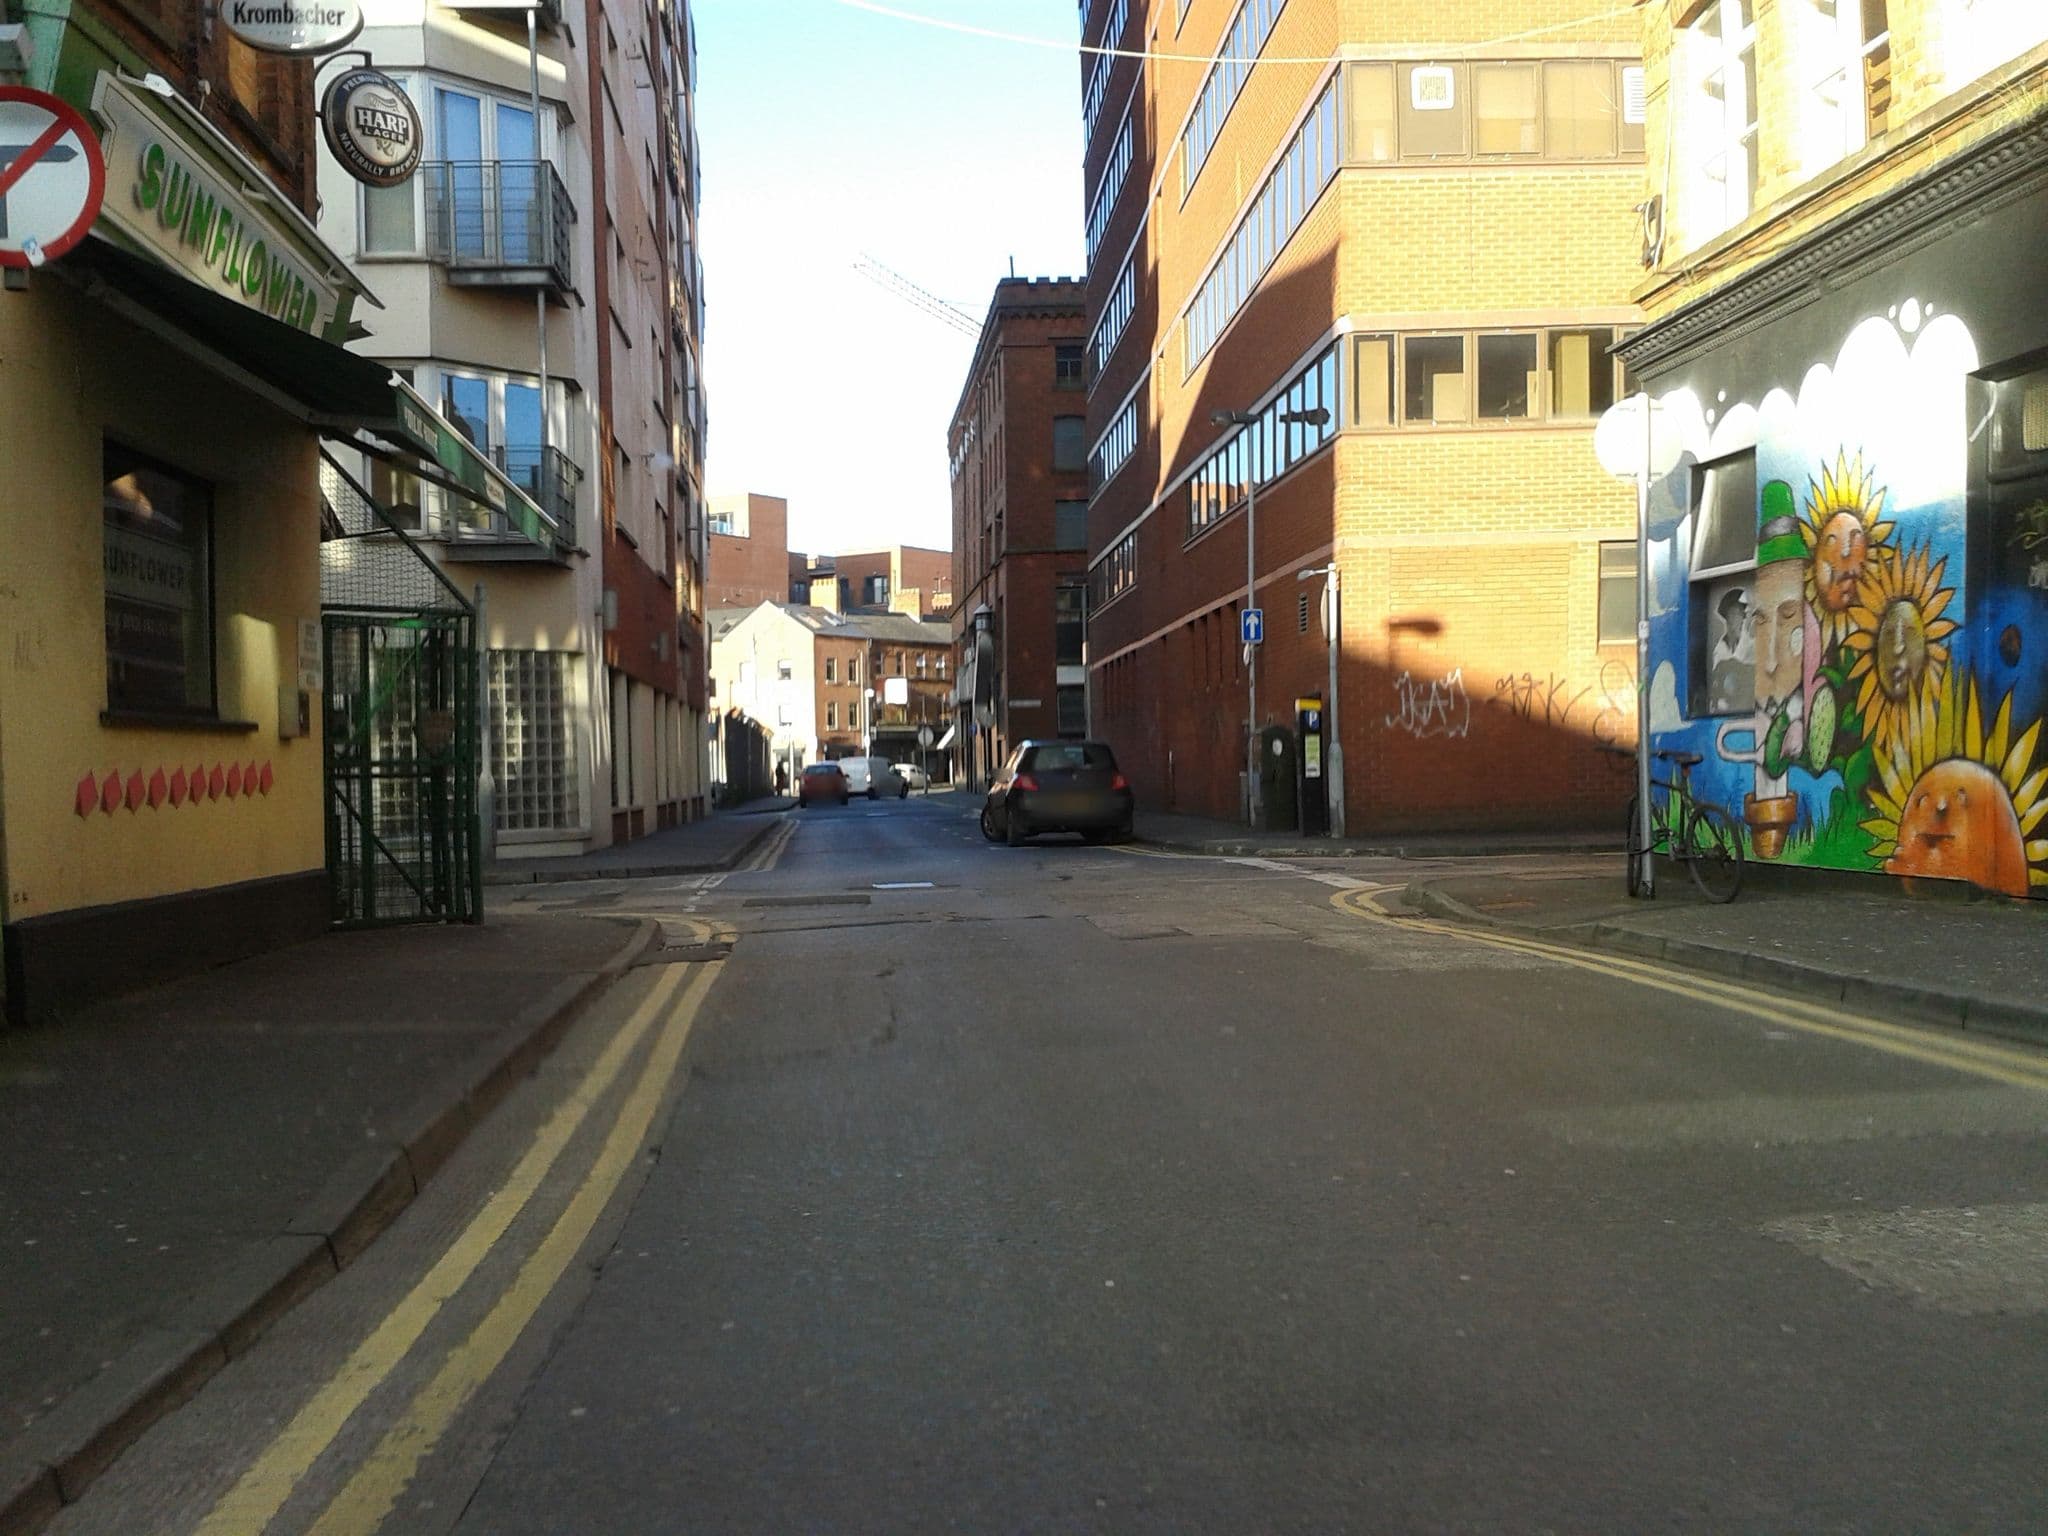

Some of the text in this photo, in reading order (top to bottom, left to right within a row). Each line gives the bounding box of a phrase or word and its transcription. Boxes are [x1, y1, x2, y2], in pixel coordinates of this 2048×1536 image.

[233, 0, 345, 26] Krombacher
[357, 108, 407, 134] HARP
[364, 127, 405, 143] LAGER
[340, 132, 384, 176] NATURALLY
[140, 143, 317, 332] SUNFLOWER
[1308, 711, 1318, 728] P
